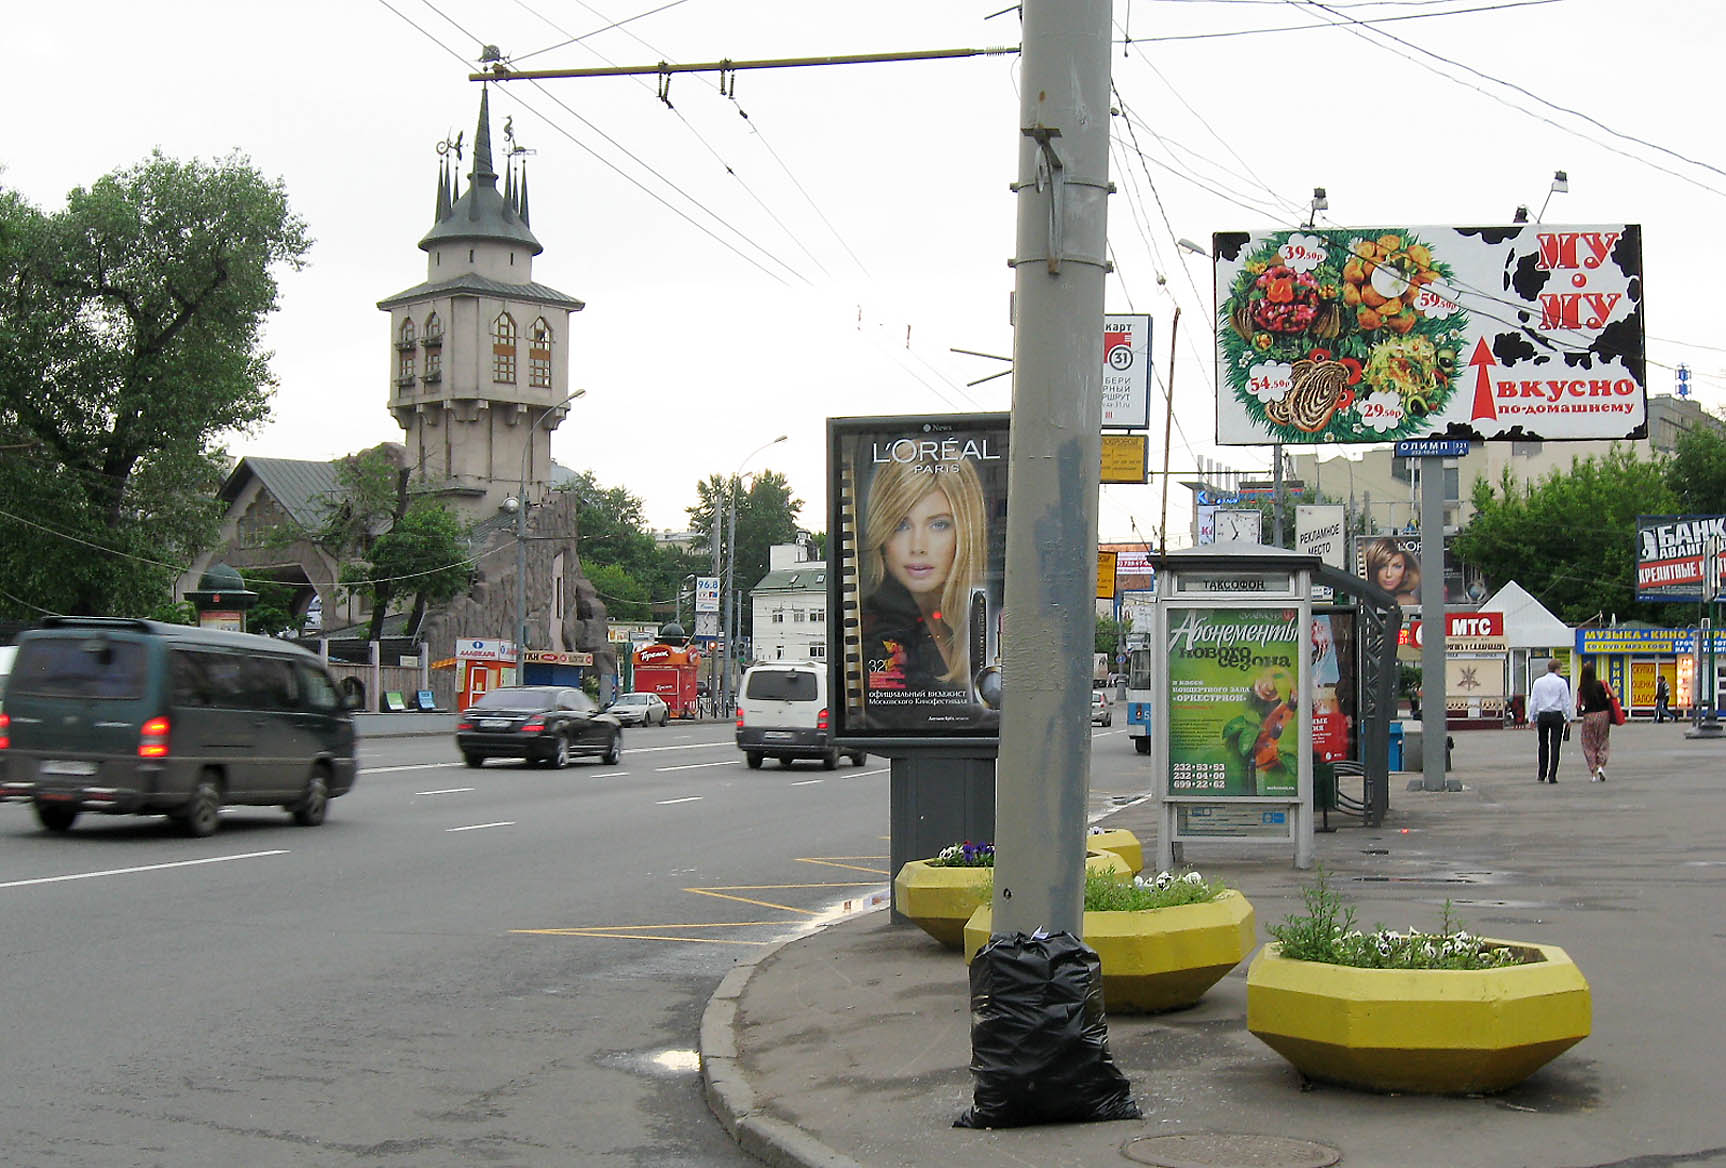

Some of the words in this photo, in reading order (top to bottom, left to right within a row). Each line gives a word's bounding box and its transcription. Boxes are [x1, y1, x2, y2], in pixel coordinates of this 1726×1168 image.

[1535, 231, 1620, 270] МУ
[1538, 293, 1622, 331] МУ
[1104, 323, 1133, 333] карт
[1114, 352, 1128, 364] 31
[1104, 376, 1131, 385] БЕРИ
[1496, 378, 1636, 403] вкусно
[1497, 402, 1635, 416] по-домашнему
[873, 436, 1001, 463] L'ORÉAL
[1400, 441, 1449, 451] ОЛИМП
[914, 464, 961, 474] PARIS
[1299, 523, 1340, 545] РЕКЛАМНОЕ
[1657, 517, 1726, 548] БАНК
[1638, 560, 1697, 585] КРЕДИТНЫЕ
[1203, 579, 1265, 591] ТАКСОФОН
[1452, 617, 1491, 636] МТС
[1584, 630, 1642, 640] МУЗЫКА
[1650, 630, 1688, 640] КИНО
[1178, 646, 1252, 659] нового
[868, 659, 886, 673] 32
[1218, 655, 1292, 672] сезона
